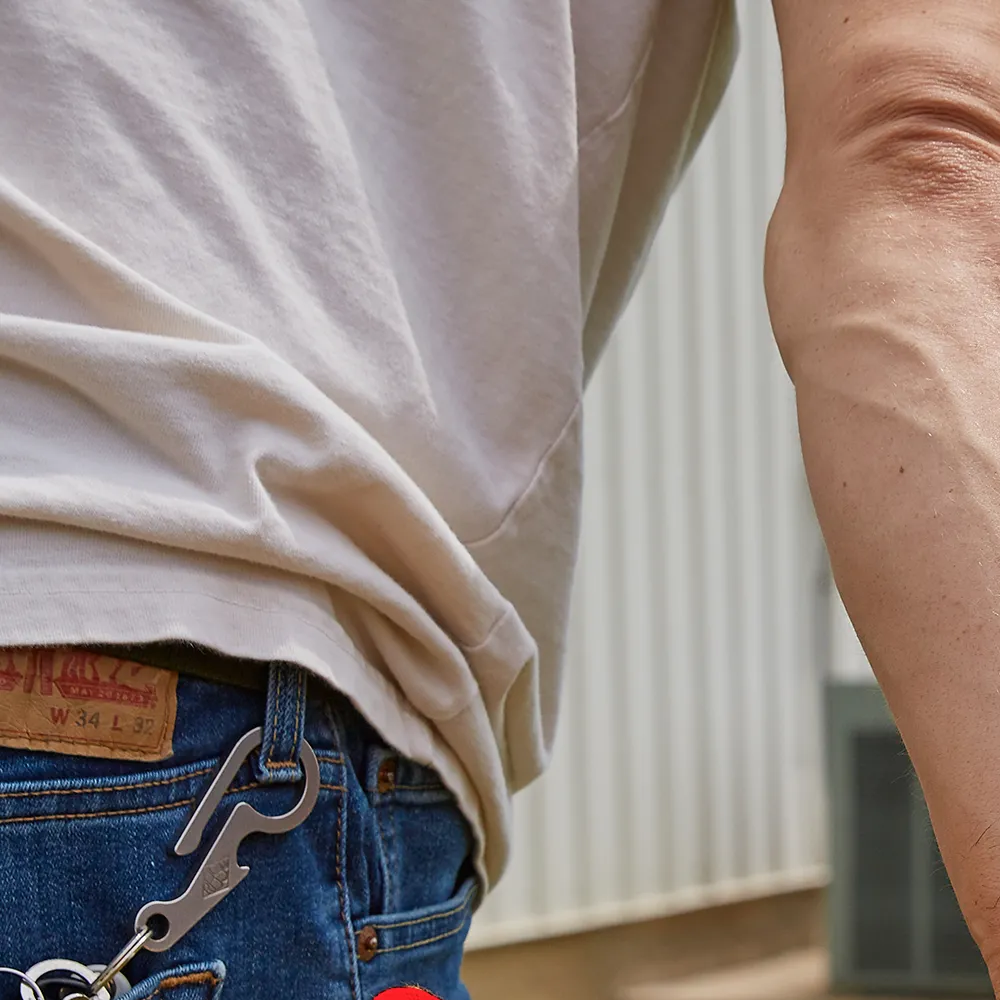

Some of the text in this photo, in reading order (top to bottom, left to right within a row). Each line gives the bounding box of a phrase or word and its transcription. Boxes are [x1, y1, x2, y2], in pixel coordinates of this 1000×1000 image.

[70, 687, 93, 697] MAY
[51, 707, 69, 725] W
[75, 708, 100, 728] 34
[111, 714, 123, 731] L
